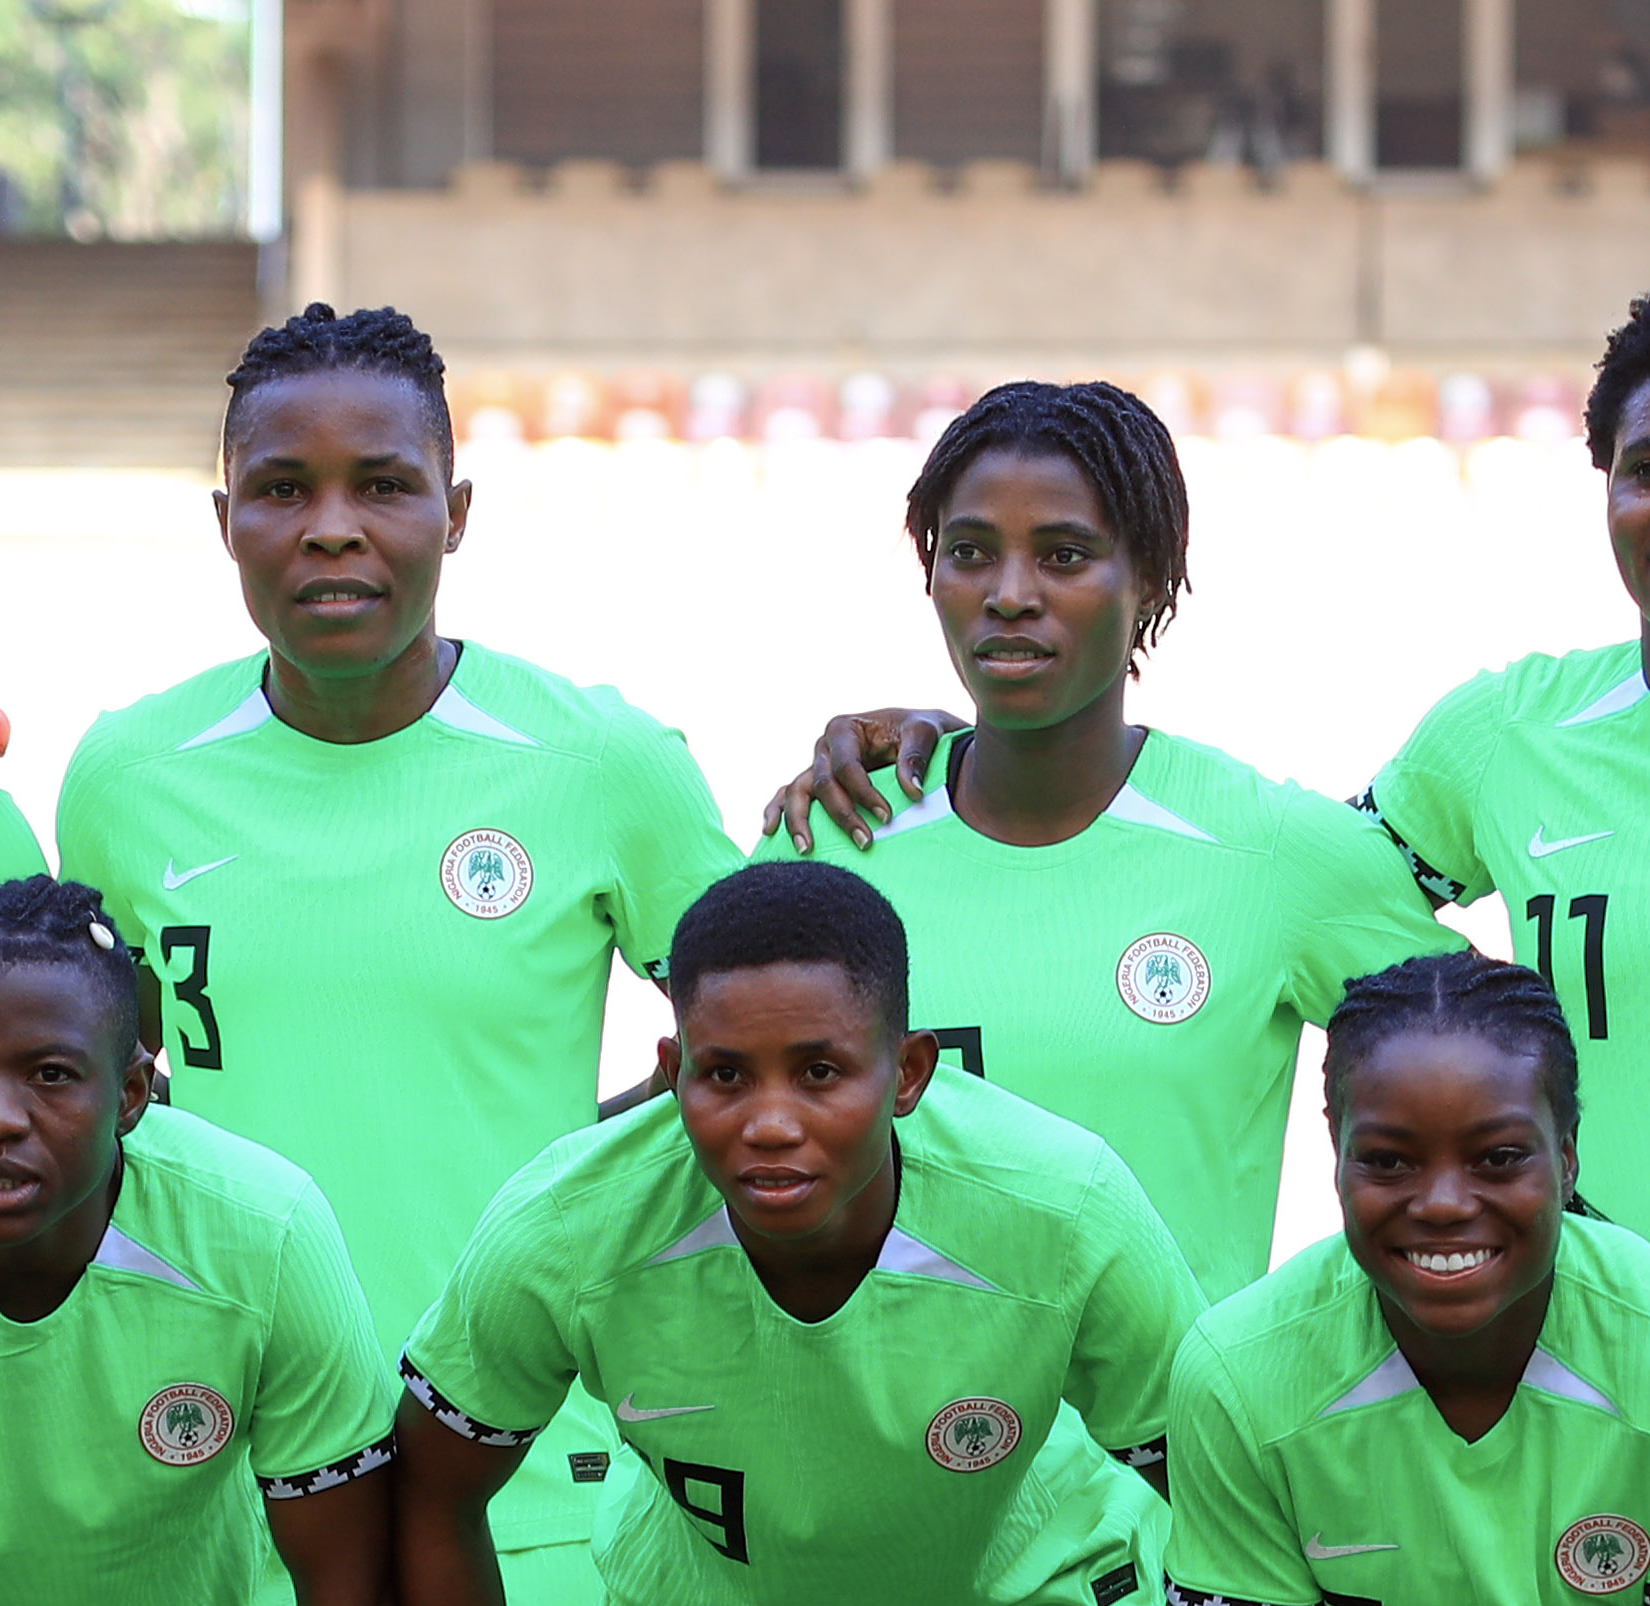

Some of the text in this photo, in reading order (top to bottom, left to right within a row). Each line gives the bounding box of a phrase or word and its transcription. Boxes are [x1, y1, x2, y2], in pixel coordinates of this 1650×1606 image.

[445, 833, 527, 904] NIGERIA FOOTBALL FEDERATION
[475, 904, 499, 914] 1945
[161, 925, 223, 1071] 3
[1121, 937, 1205, 1008] NIGERIA FOOTBALL FEDERATION
[1526, 894, 1609, 1040] 11
[1153, 1009, 1175, 1018] 1945
[145, 1388, 229, 1456] NIGERIA FOOTBALL FEDERATION
[931, 1402, 1017, 1464] NIGERIA FOOTBALL FEDERATION
[181, 1449, 205, 1461] 1945
[967, 1456, 991, 1468] 1945
[1561, 1520, 1648, 1586] NIGERIA FOOTBALL FEDERATION
[1601, 1576, 1626, 1589] 1945
